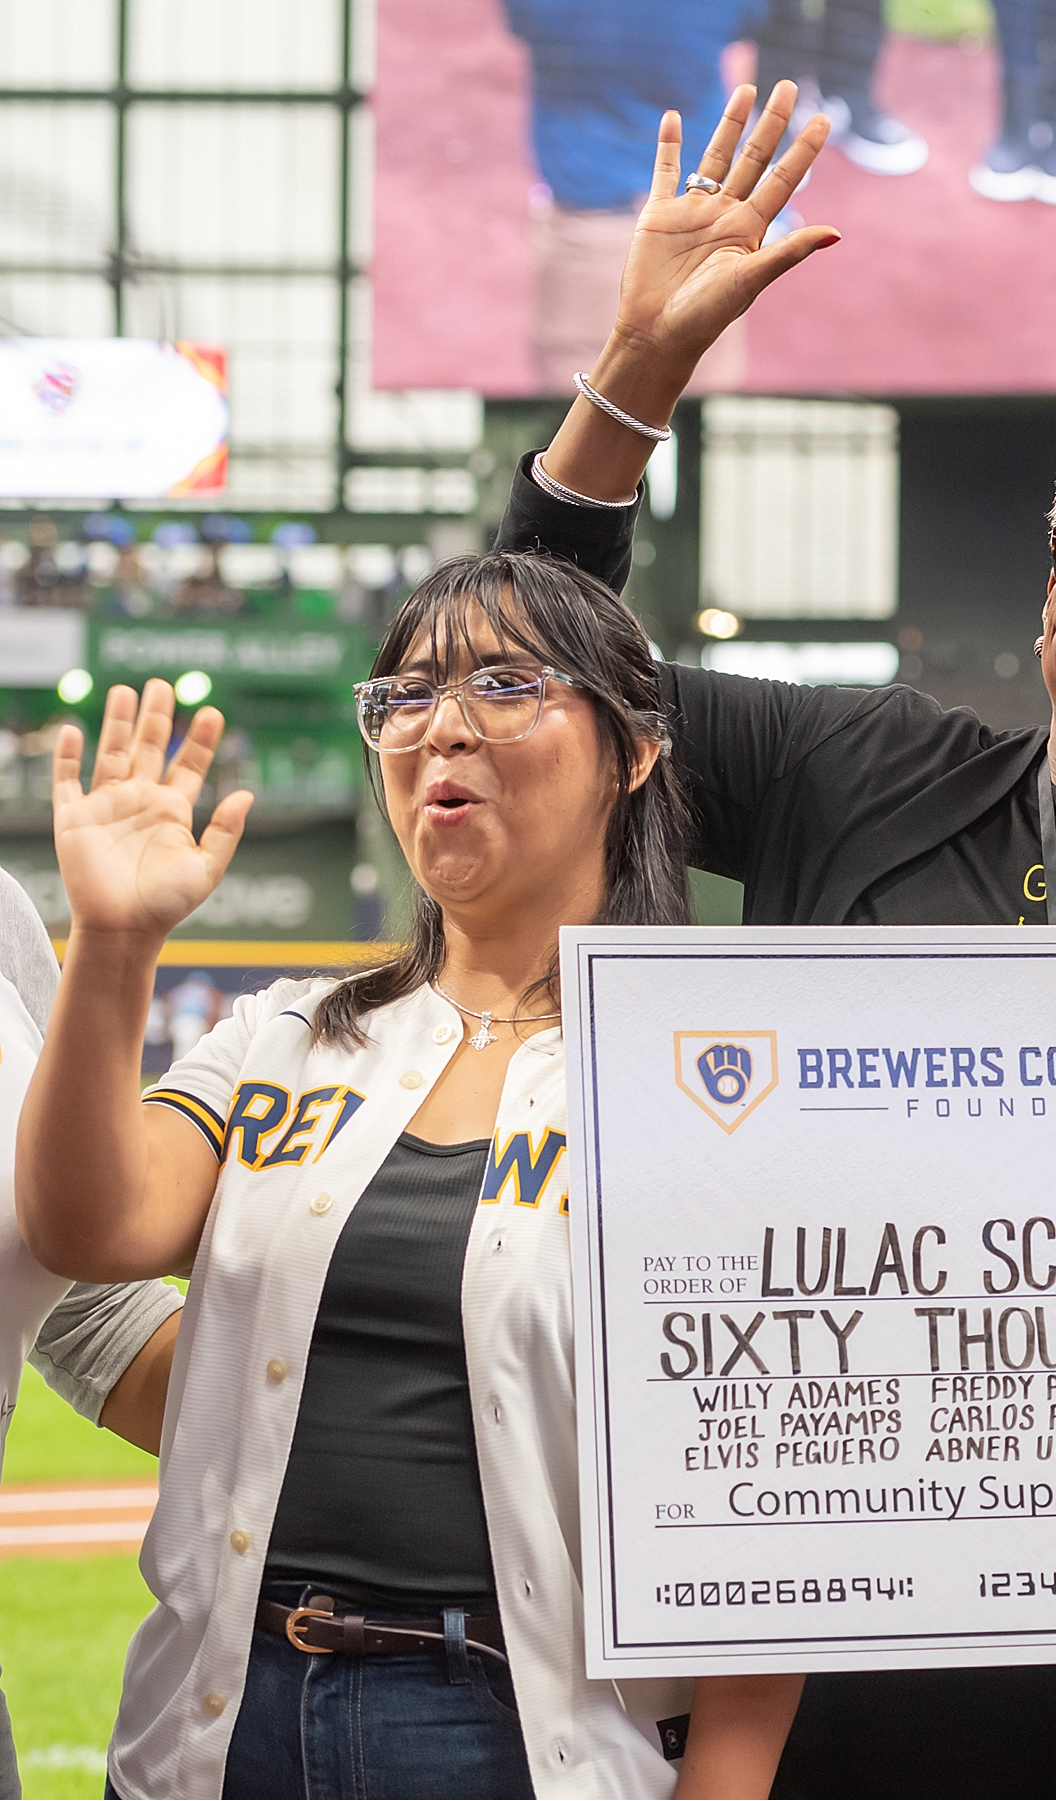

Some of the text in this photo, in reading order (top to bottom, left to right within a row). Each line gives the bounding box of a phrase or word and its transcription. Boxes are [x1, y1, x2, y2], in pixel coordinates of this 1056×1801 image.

[797, 1046, 1004, 1090] BREWERS
[643, 1255, 759, 1272] PAY TO THE
[761, 1222, 947, 1298] LULAC
[643, 1276, 747, 1295] ORDER OF
[661, 1308, 864, 1380] SIXTY
[693, 1383, 773, 1414] WILLY
[788, 1377, 901, 1410] ADAMES
[930, 1374, 1034, 1404] FREDDY
[698, 1416, 766, 1441] JOEL
[780, 1409, 902, 1436] PAYAMPS
[929, 1403, 1034, 1434] CARLOS
[685, 1442, 759, 1472] ELVIS
[775, 1436, 900, 1468] PEGUERO
[924, 1435, 1021, 1463] ABNER
[655, 1502, 696, 1520] FOR
[728, 1477, 966, 1521] Community
